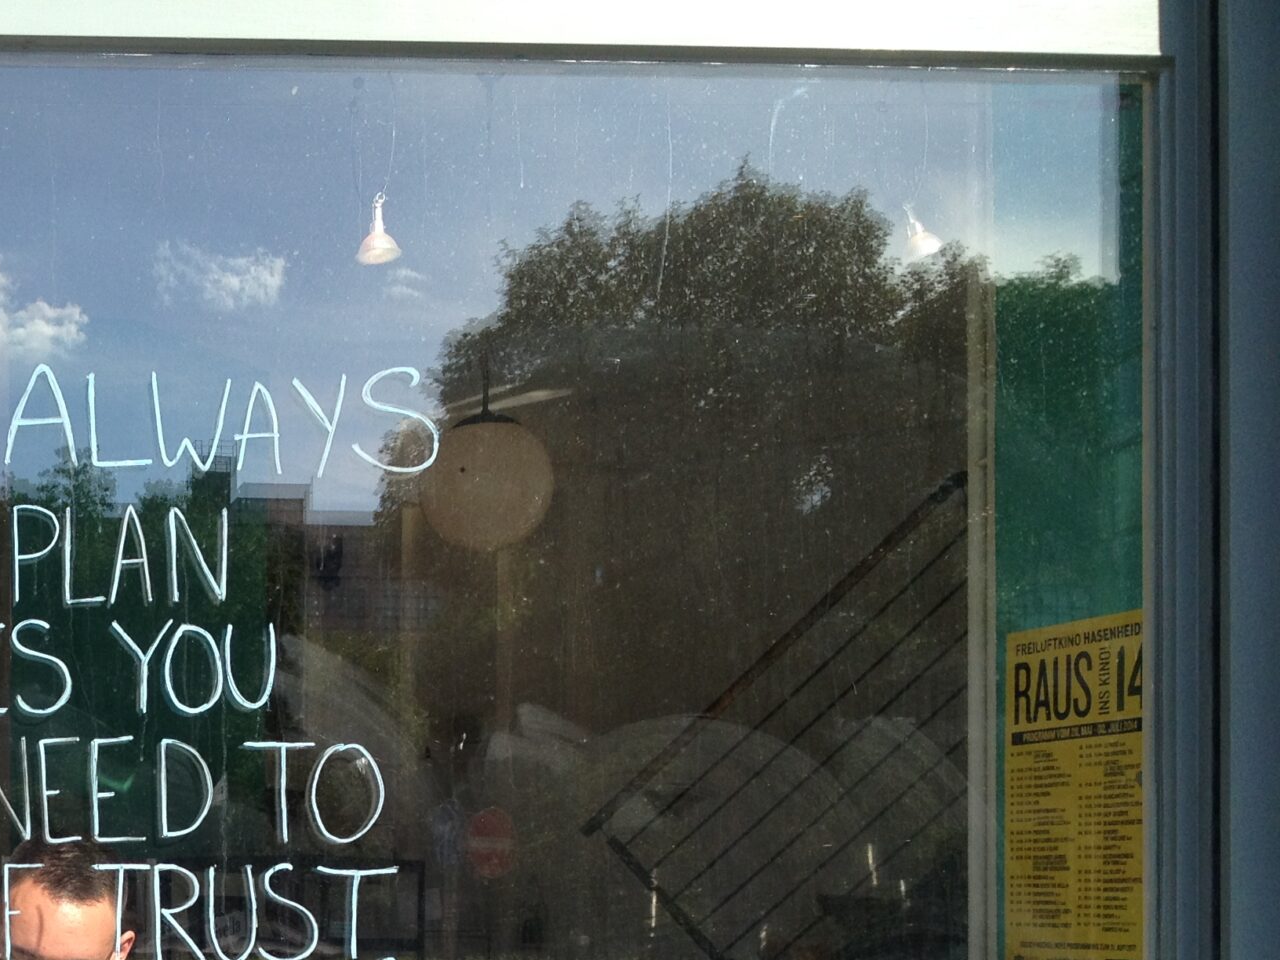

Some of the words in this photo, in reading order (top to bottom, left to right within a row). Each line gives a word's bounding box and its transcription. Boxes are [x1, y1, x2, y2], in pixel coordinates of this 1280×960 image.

[4, 363, 440, 477] ALWAYS
[13, 504, 229, 606] PLAN
[111, 618, 277, 715] YOU
[1014, 650, 1093, 726] RAUS
[1015, 633, 1082, 657] FREILUFTKINO
[1083, 622, 1142, 645] HASENHEID
[1098, 690, 1110, 716] INS
[241, 741, 386, 845] TO
